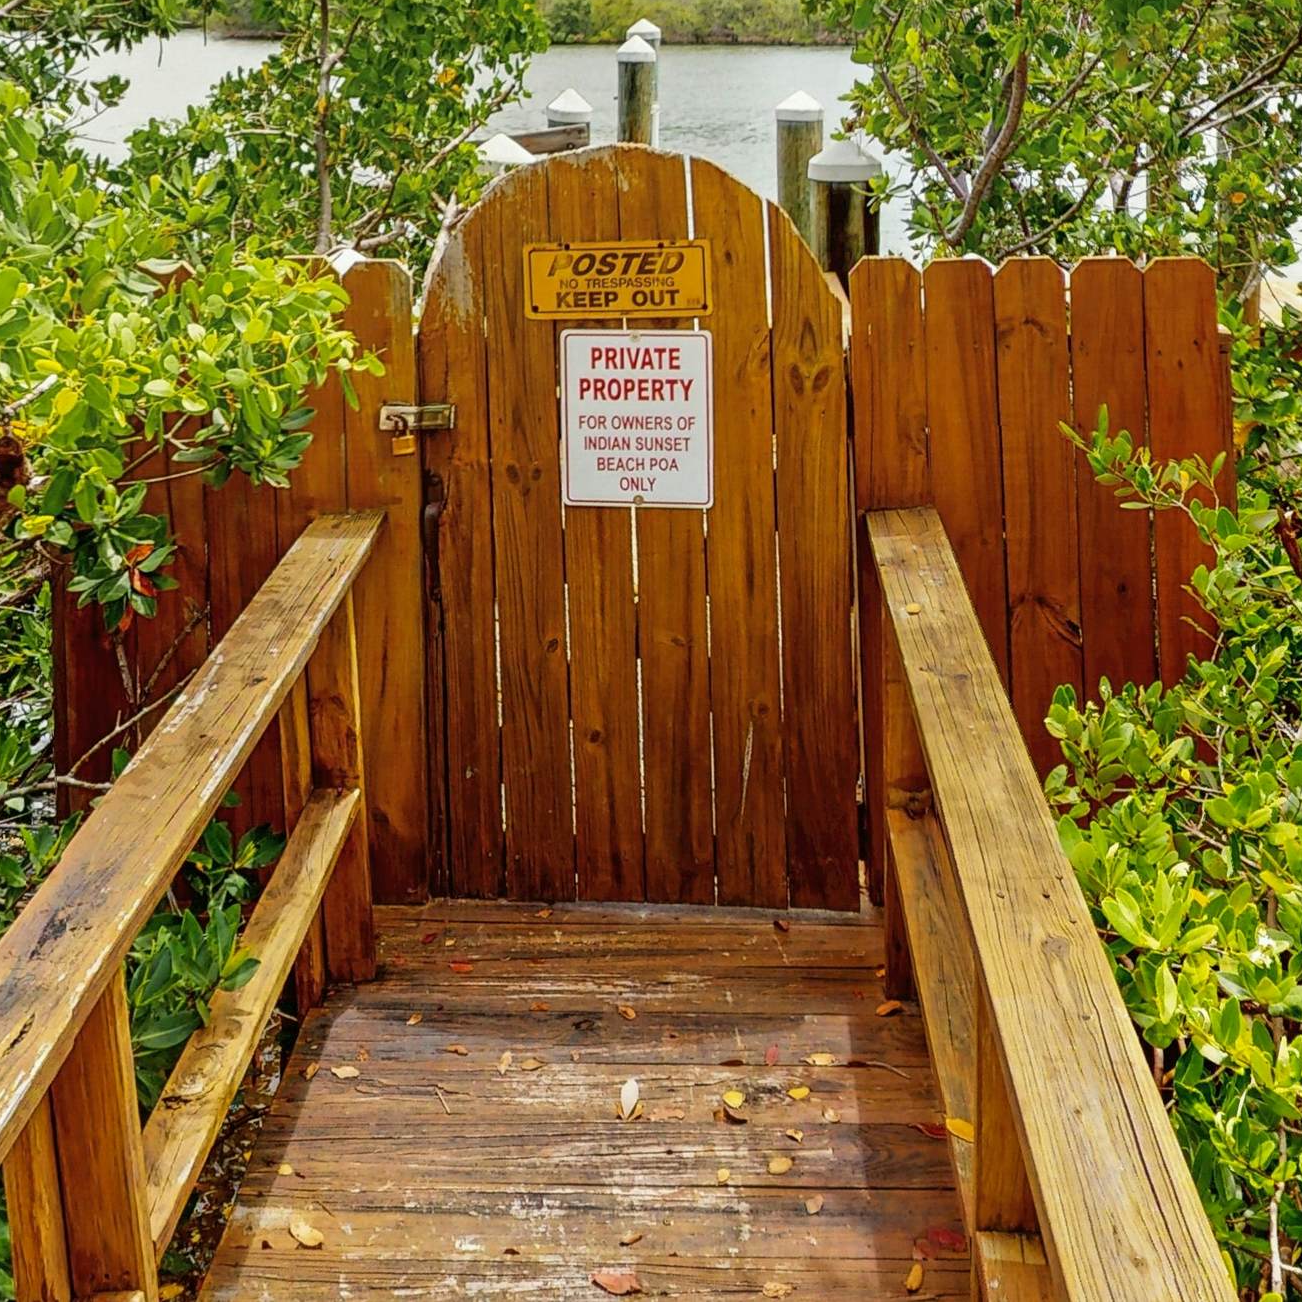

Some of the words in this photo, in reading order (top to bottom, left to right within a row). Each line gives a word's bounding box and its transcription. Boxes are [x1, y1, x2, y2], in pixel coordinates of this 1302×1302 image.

[548, 252, 685, 277] POSTED
[559, 279, 579, 290] NO
[585, 277, 675, 289] TRESPASSING
[556, 291, 619, 308] KEEP
[631, 290, 680, 307] OUT
[591, 347, 681, 370] PRIVATE
[579, 378, 694, 401] PROPERTY
[578, 415, 607, 430] FOR
[611, 415, 673, 430] OWNERS
[677, 416, 696, 431] OF
[584, 436, 631, 451] INDIAN
[635, 436, 691, 452] SUNSET
[597, 457, 645, 471] BEACH
[649, 458, 679, 472] POA
[619, 477, 657, 492] ONLY
